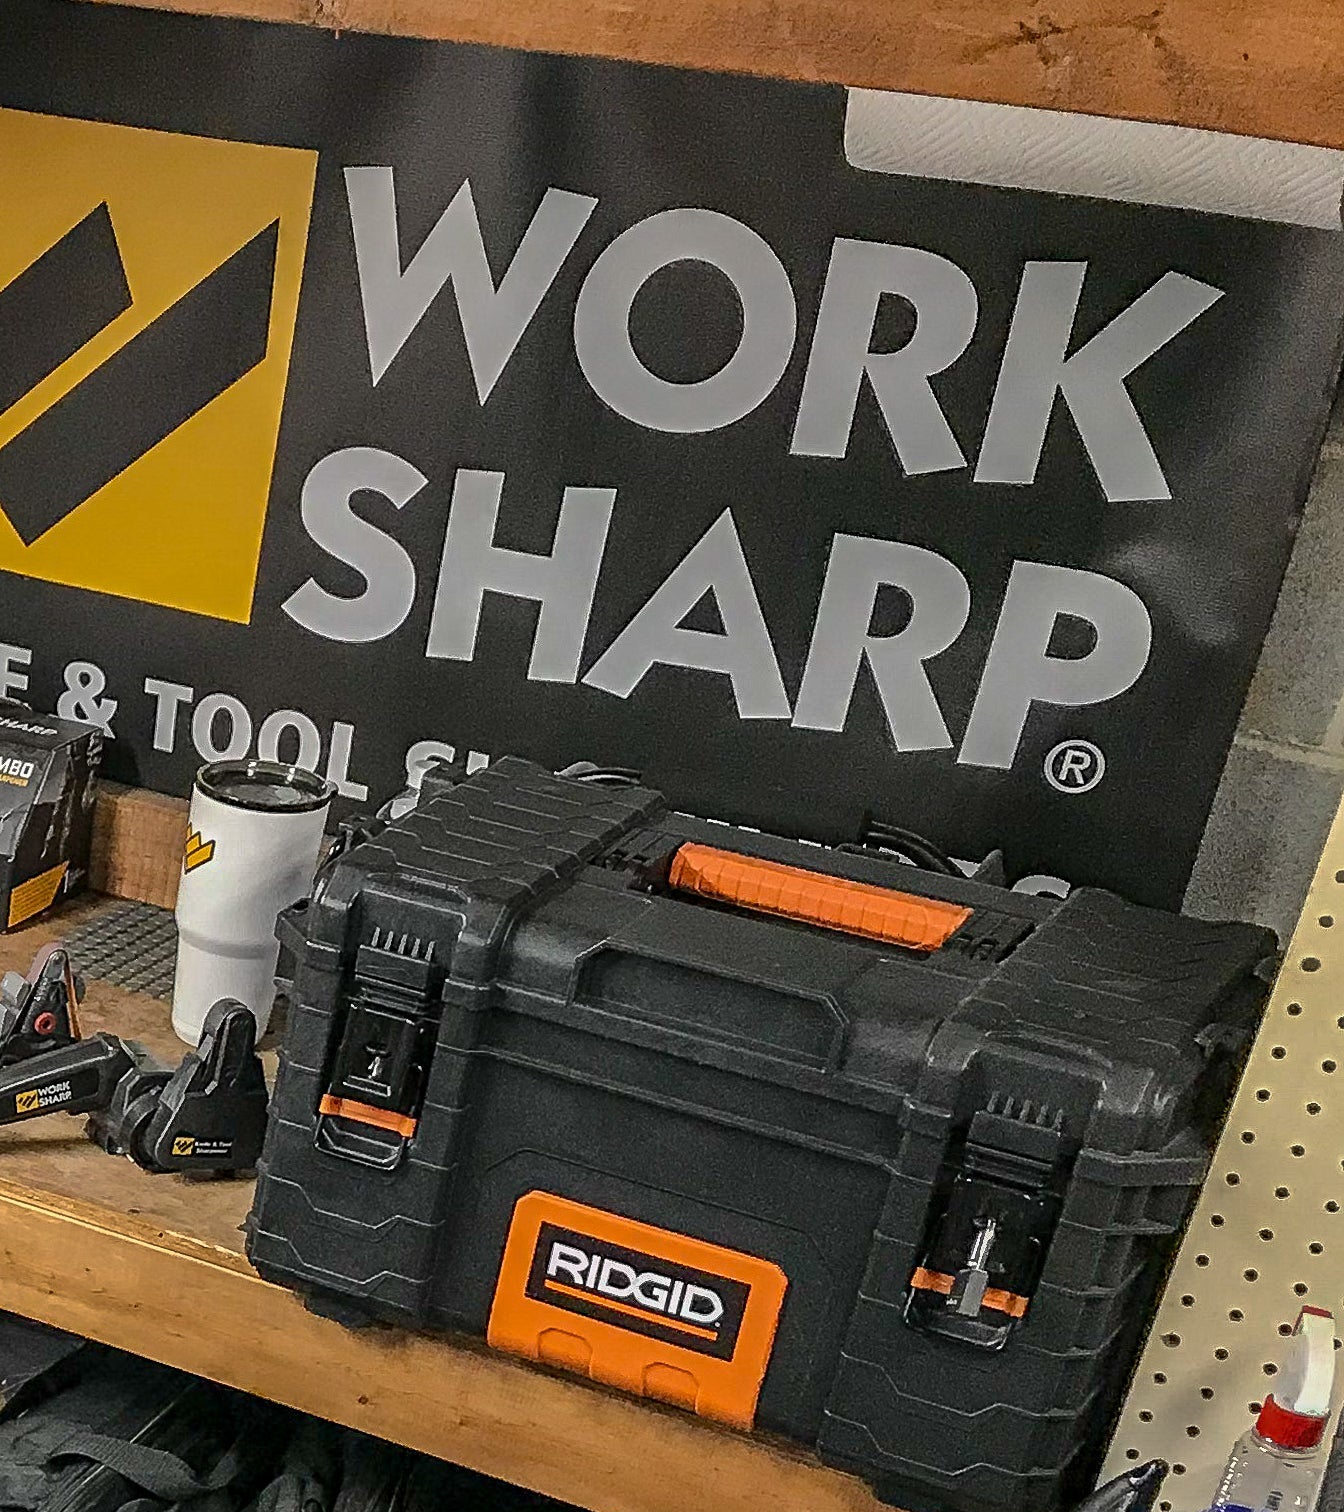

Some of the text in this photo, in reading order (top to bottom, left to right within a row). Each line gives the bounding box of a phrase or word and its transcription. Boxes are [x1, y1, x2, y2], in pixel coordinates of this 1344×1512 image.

[343, 165, 1226, 502] WORK
[281, 446, 1152, 768] SHARP
[56, 661, 118, 739] &
[144, 677, 370, 801] TOOL
[37, 1080, 72, 1097] WORK
[39, 1091, 73, 1107] SHARP
[545, 1241, 724, 1324] RIDGID
